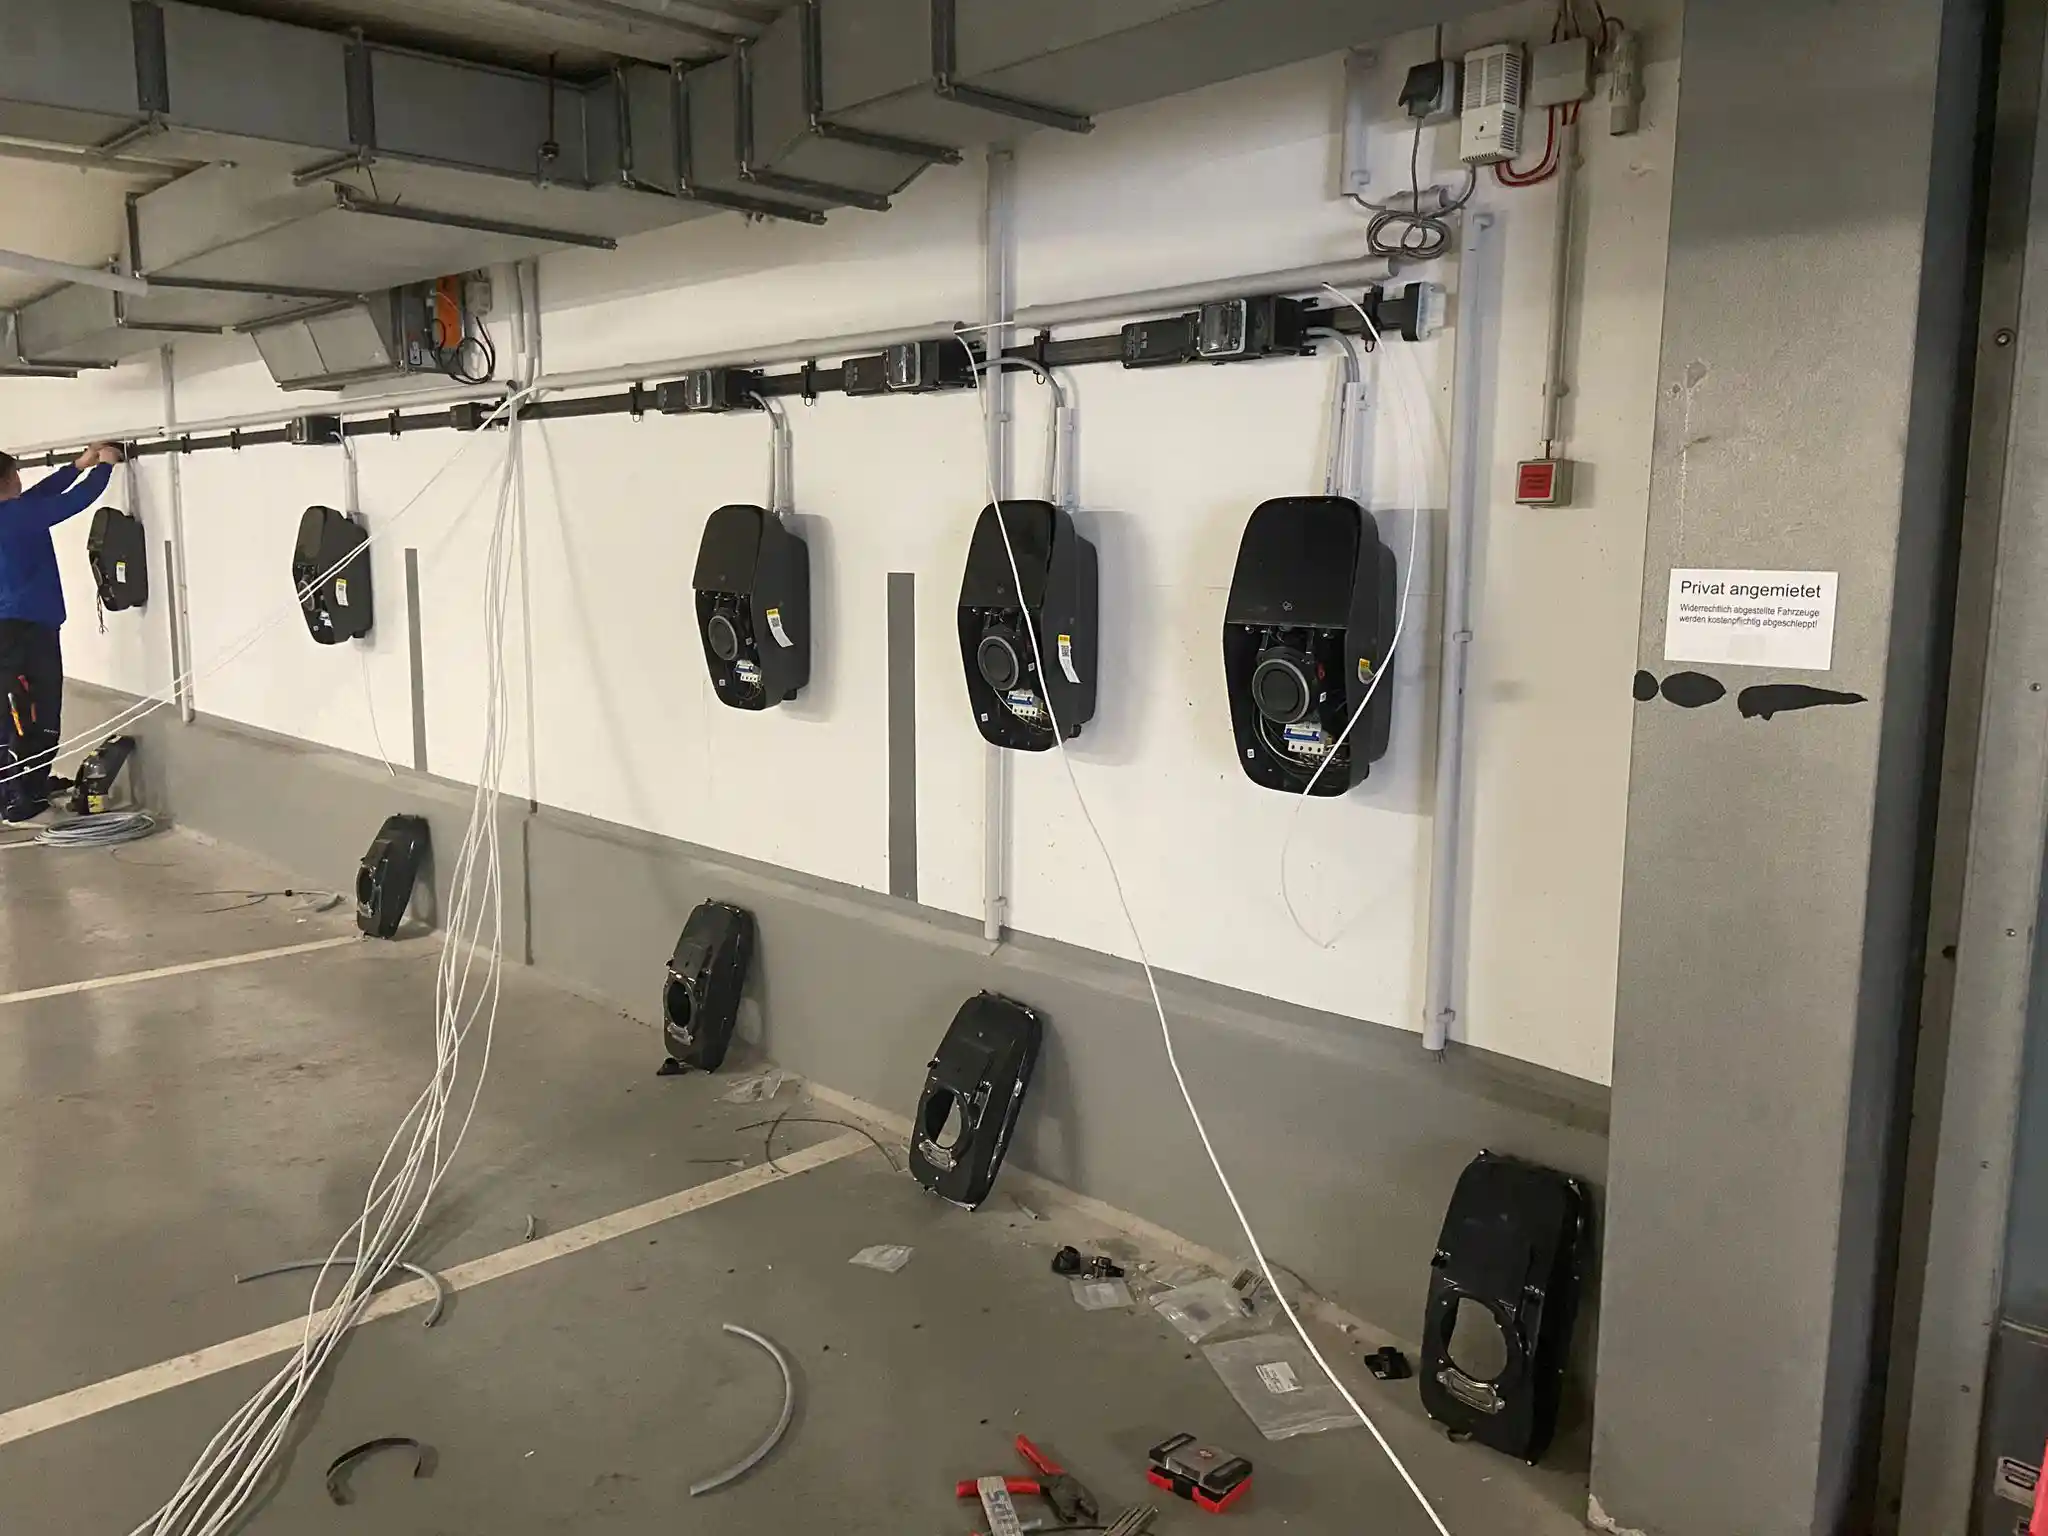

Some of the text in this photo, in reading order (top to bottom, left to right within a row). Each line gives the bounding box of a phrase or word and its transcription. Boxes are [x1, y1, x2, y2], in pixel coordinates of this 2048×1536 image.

[1680, 580, 1821, 600] Privat angemietet
[1680, 603, 1820, 618] Widerrechtlich abgestellte Fahrzeuge
[1679, 614, 1818, 629] werden kostenpflichtig abgeschleppt!
